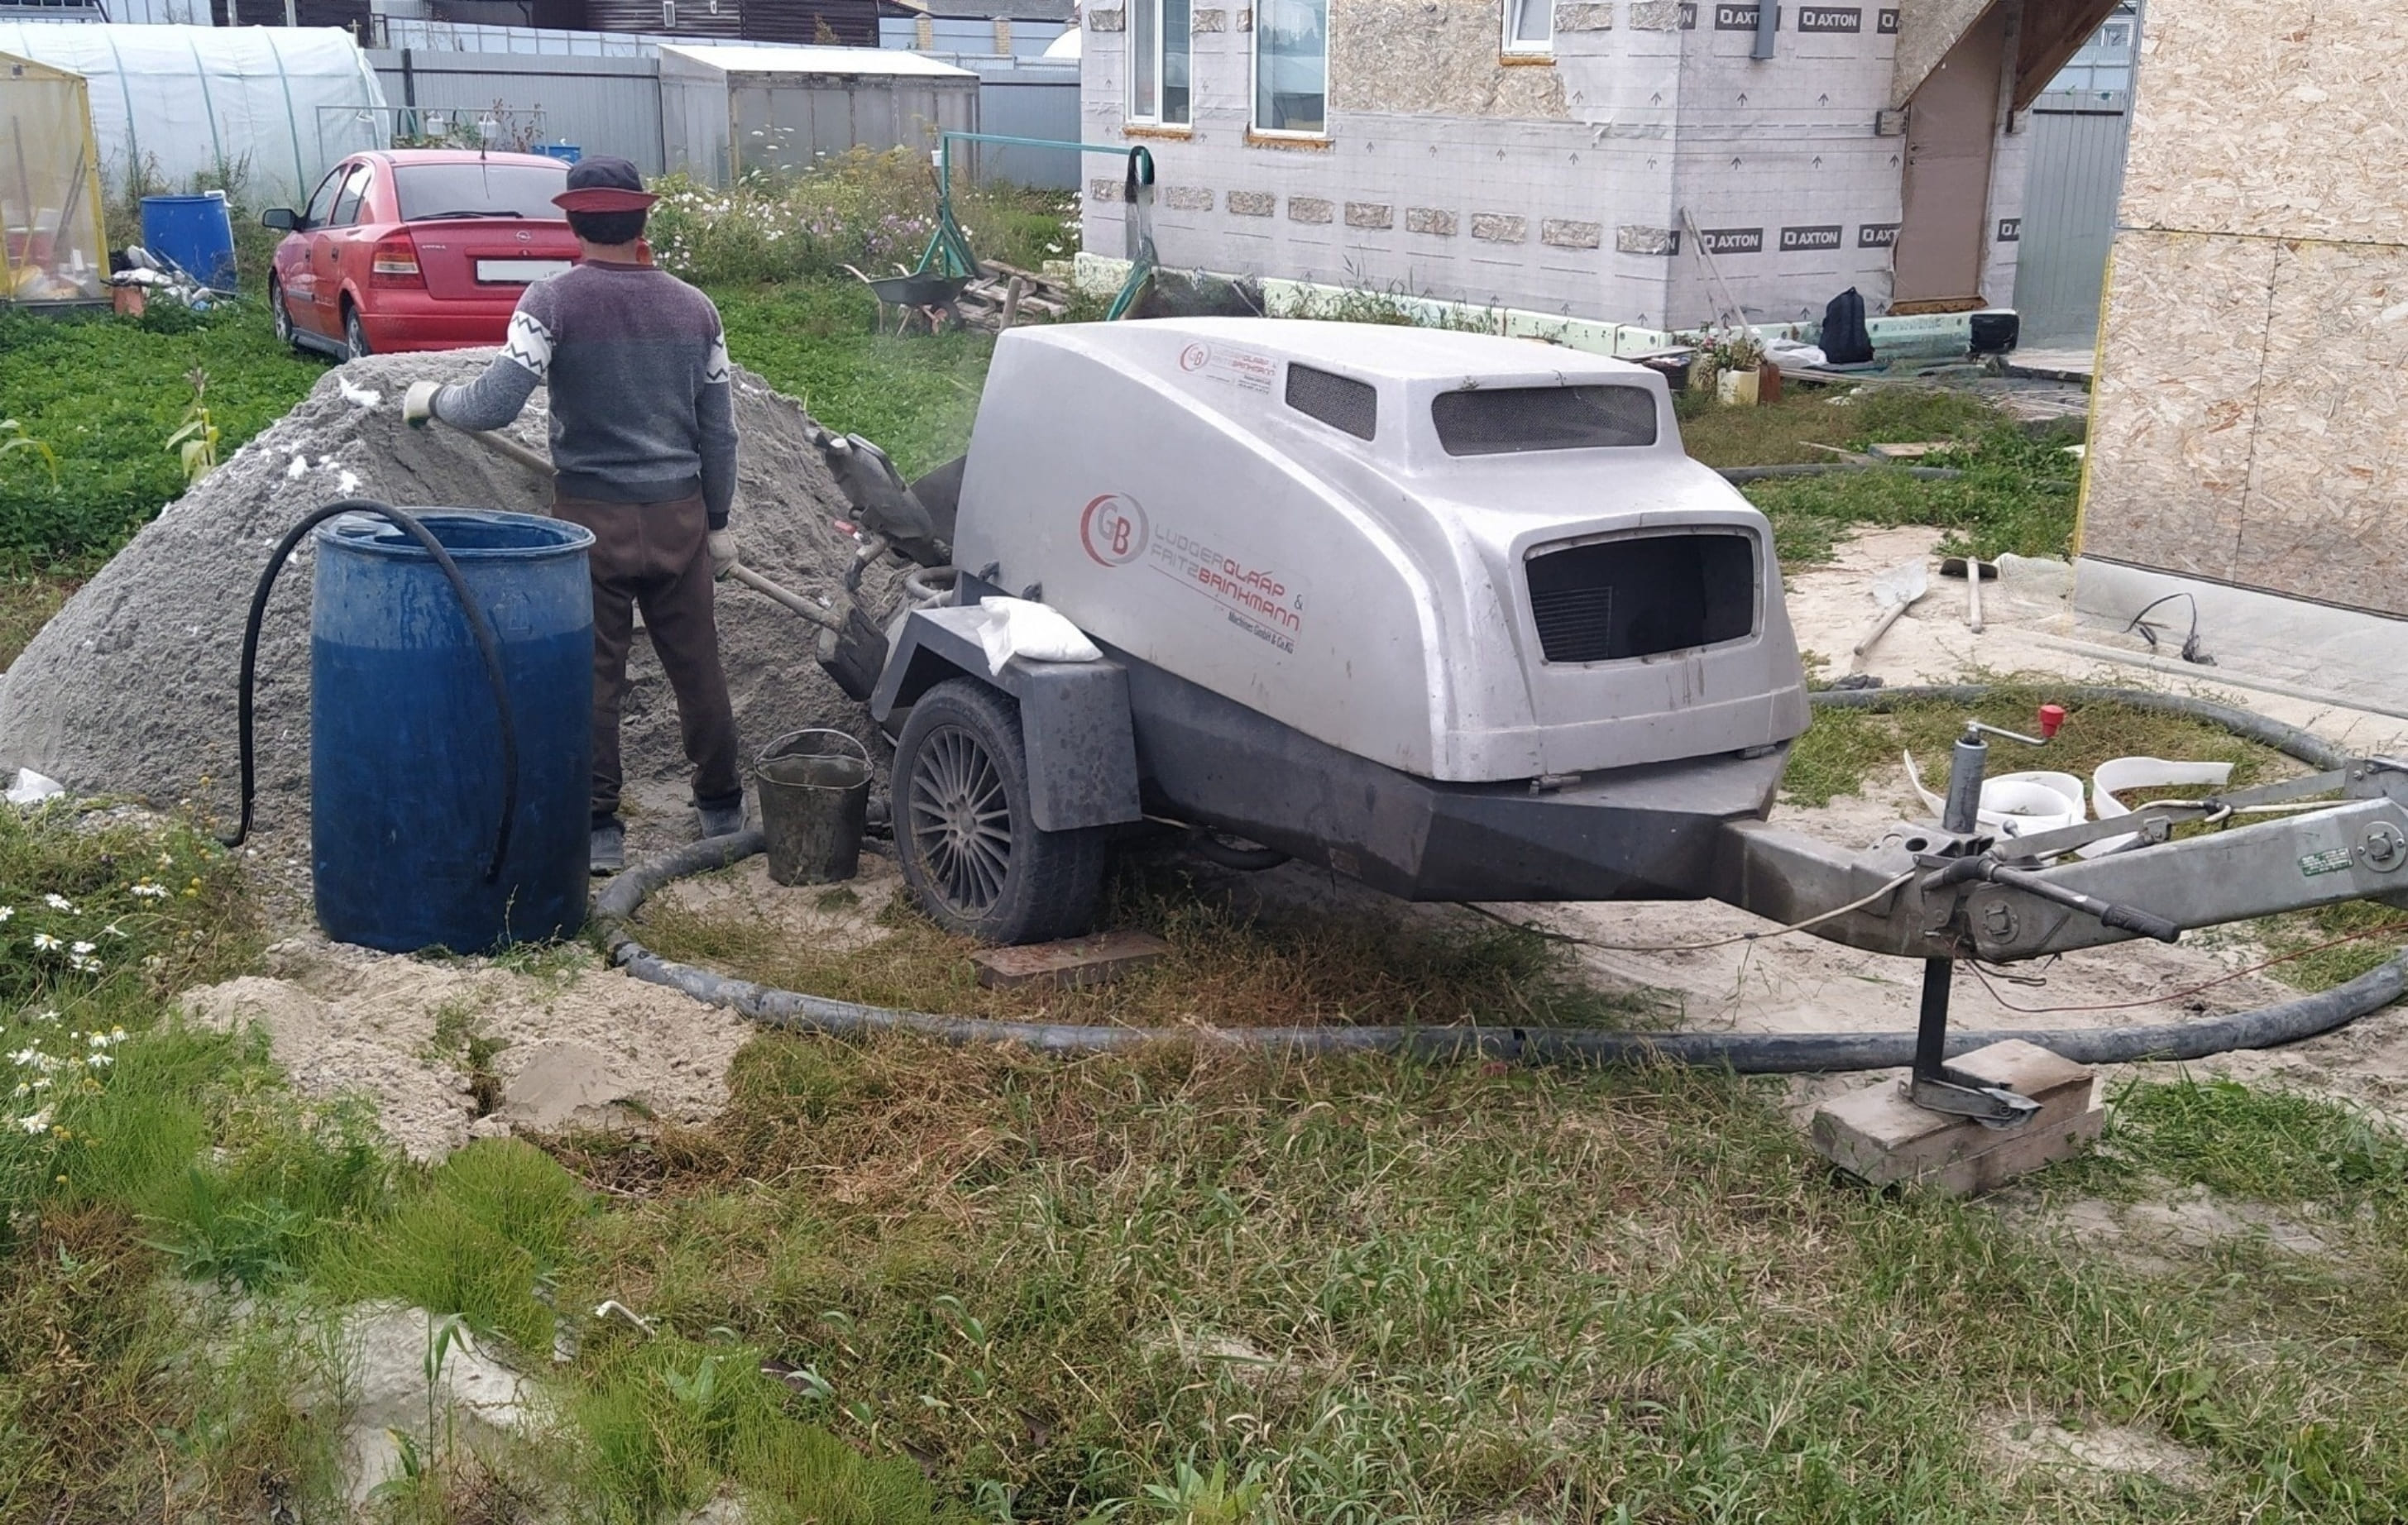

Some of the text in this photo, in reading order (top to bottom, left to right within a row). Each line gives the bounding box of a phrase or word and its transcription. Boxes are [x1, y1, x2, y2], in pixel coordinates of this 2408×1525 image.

[1817, 13, 1858, 27] AXTON
[1717, 234, 1759, 248] AXTON
[1798, 231, 1838, 246] AXTON
[1294, 593, 1304, 611] &
